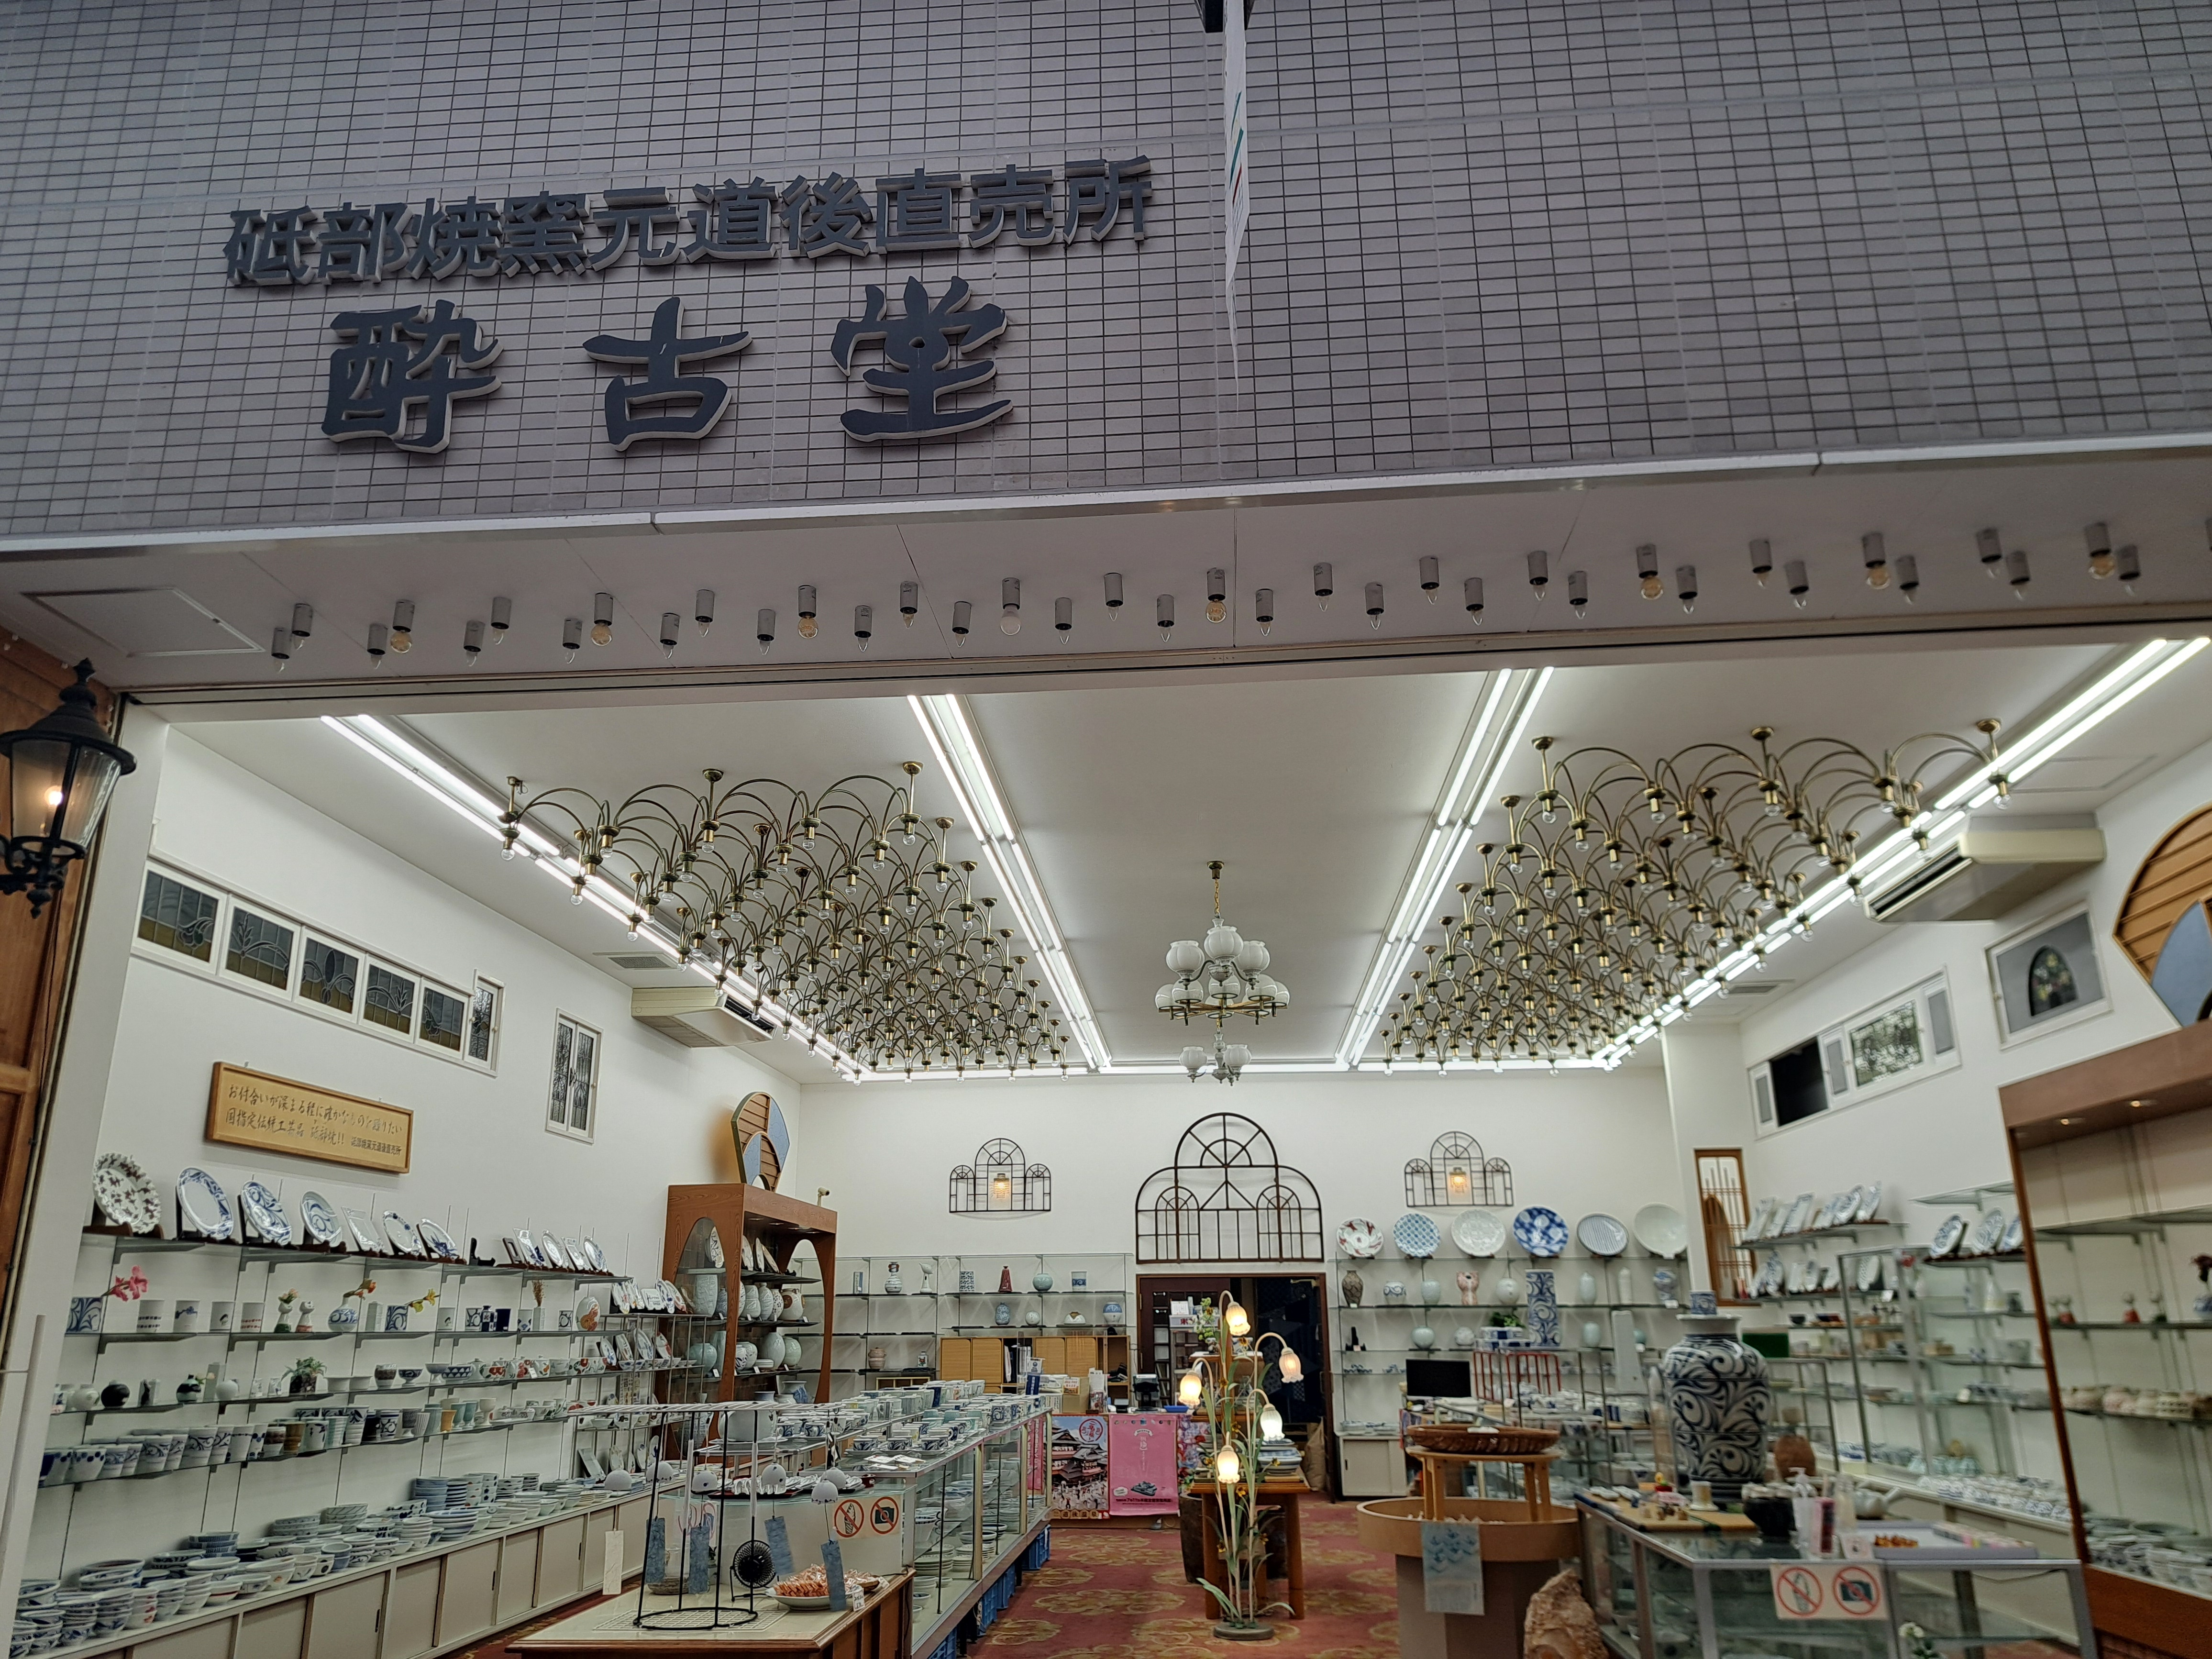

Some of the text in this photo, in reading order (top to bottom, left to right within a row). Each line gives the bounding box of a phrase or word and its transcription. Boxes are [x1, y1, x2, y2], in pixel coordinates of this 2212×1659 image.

[223, 155, 1152, 286] 砥部焼窯元道後直売所
[321, 276, 1013, 453] 酔古堂
